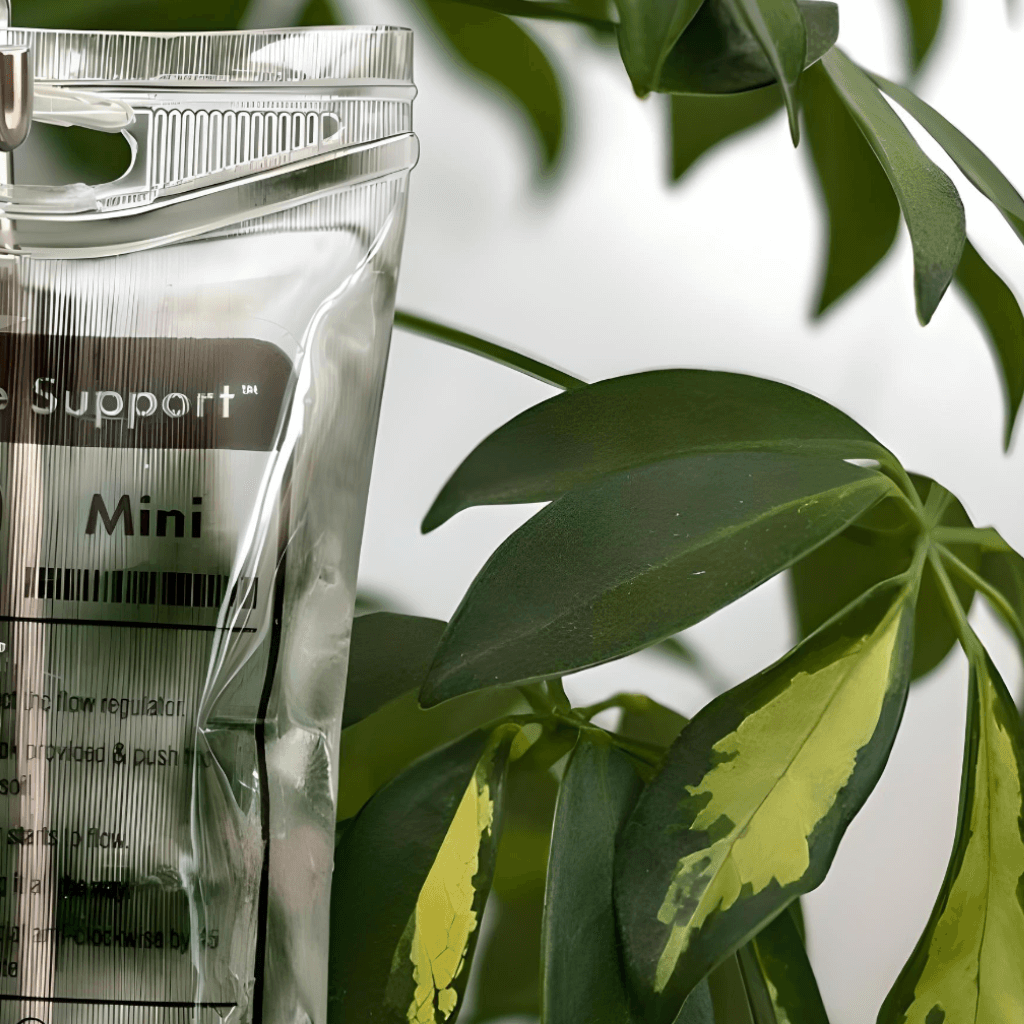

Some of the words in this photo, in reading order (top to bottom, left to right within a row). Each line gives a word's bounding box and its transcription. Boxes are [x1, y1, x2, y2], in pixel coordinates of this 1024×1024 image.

[85, 493, 202, 539] Mini
[113, 742, 127, 764] &
[134, 744, 178, 766] push
